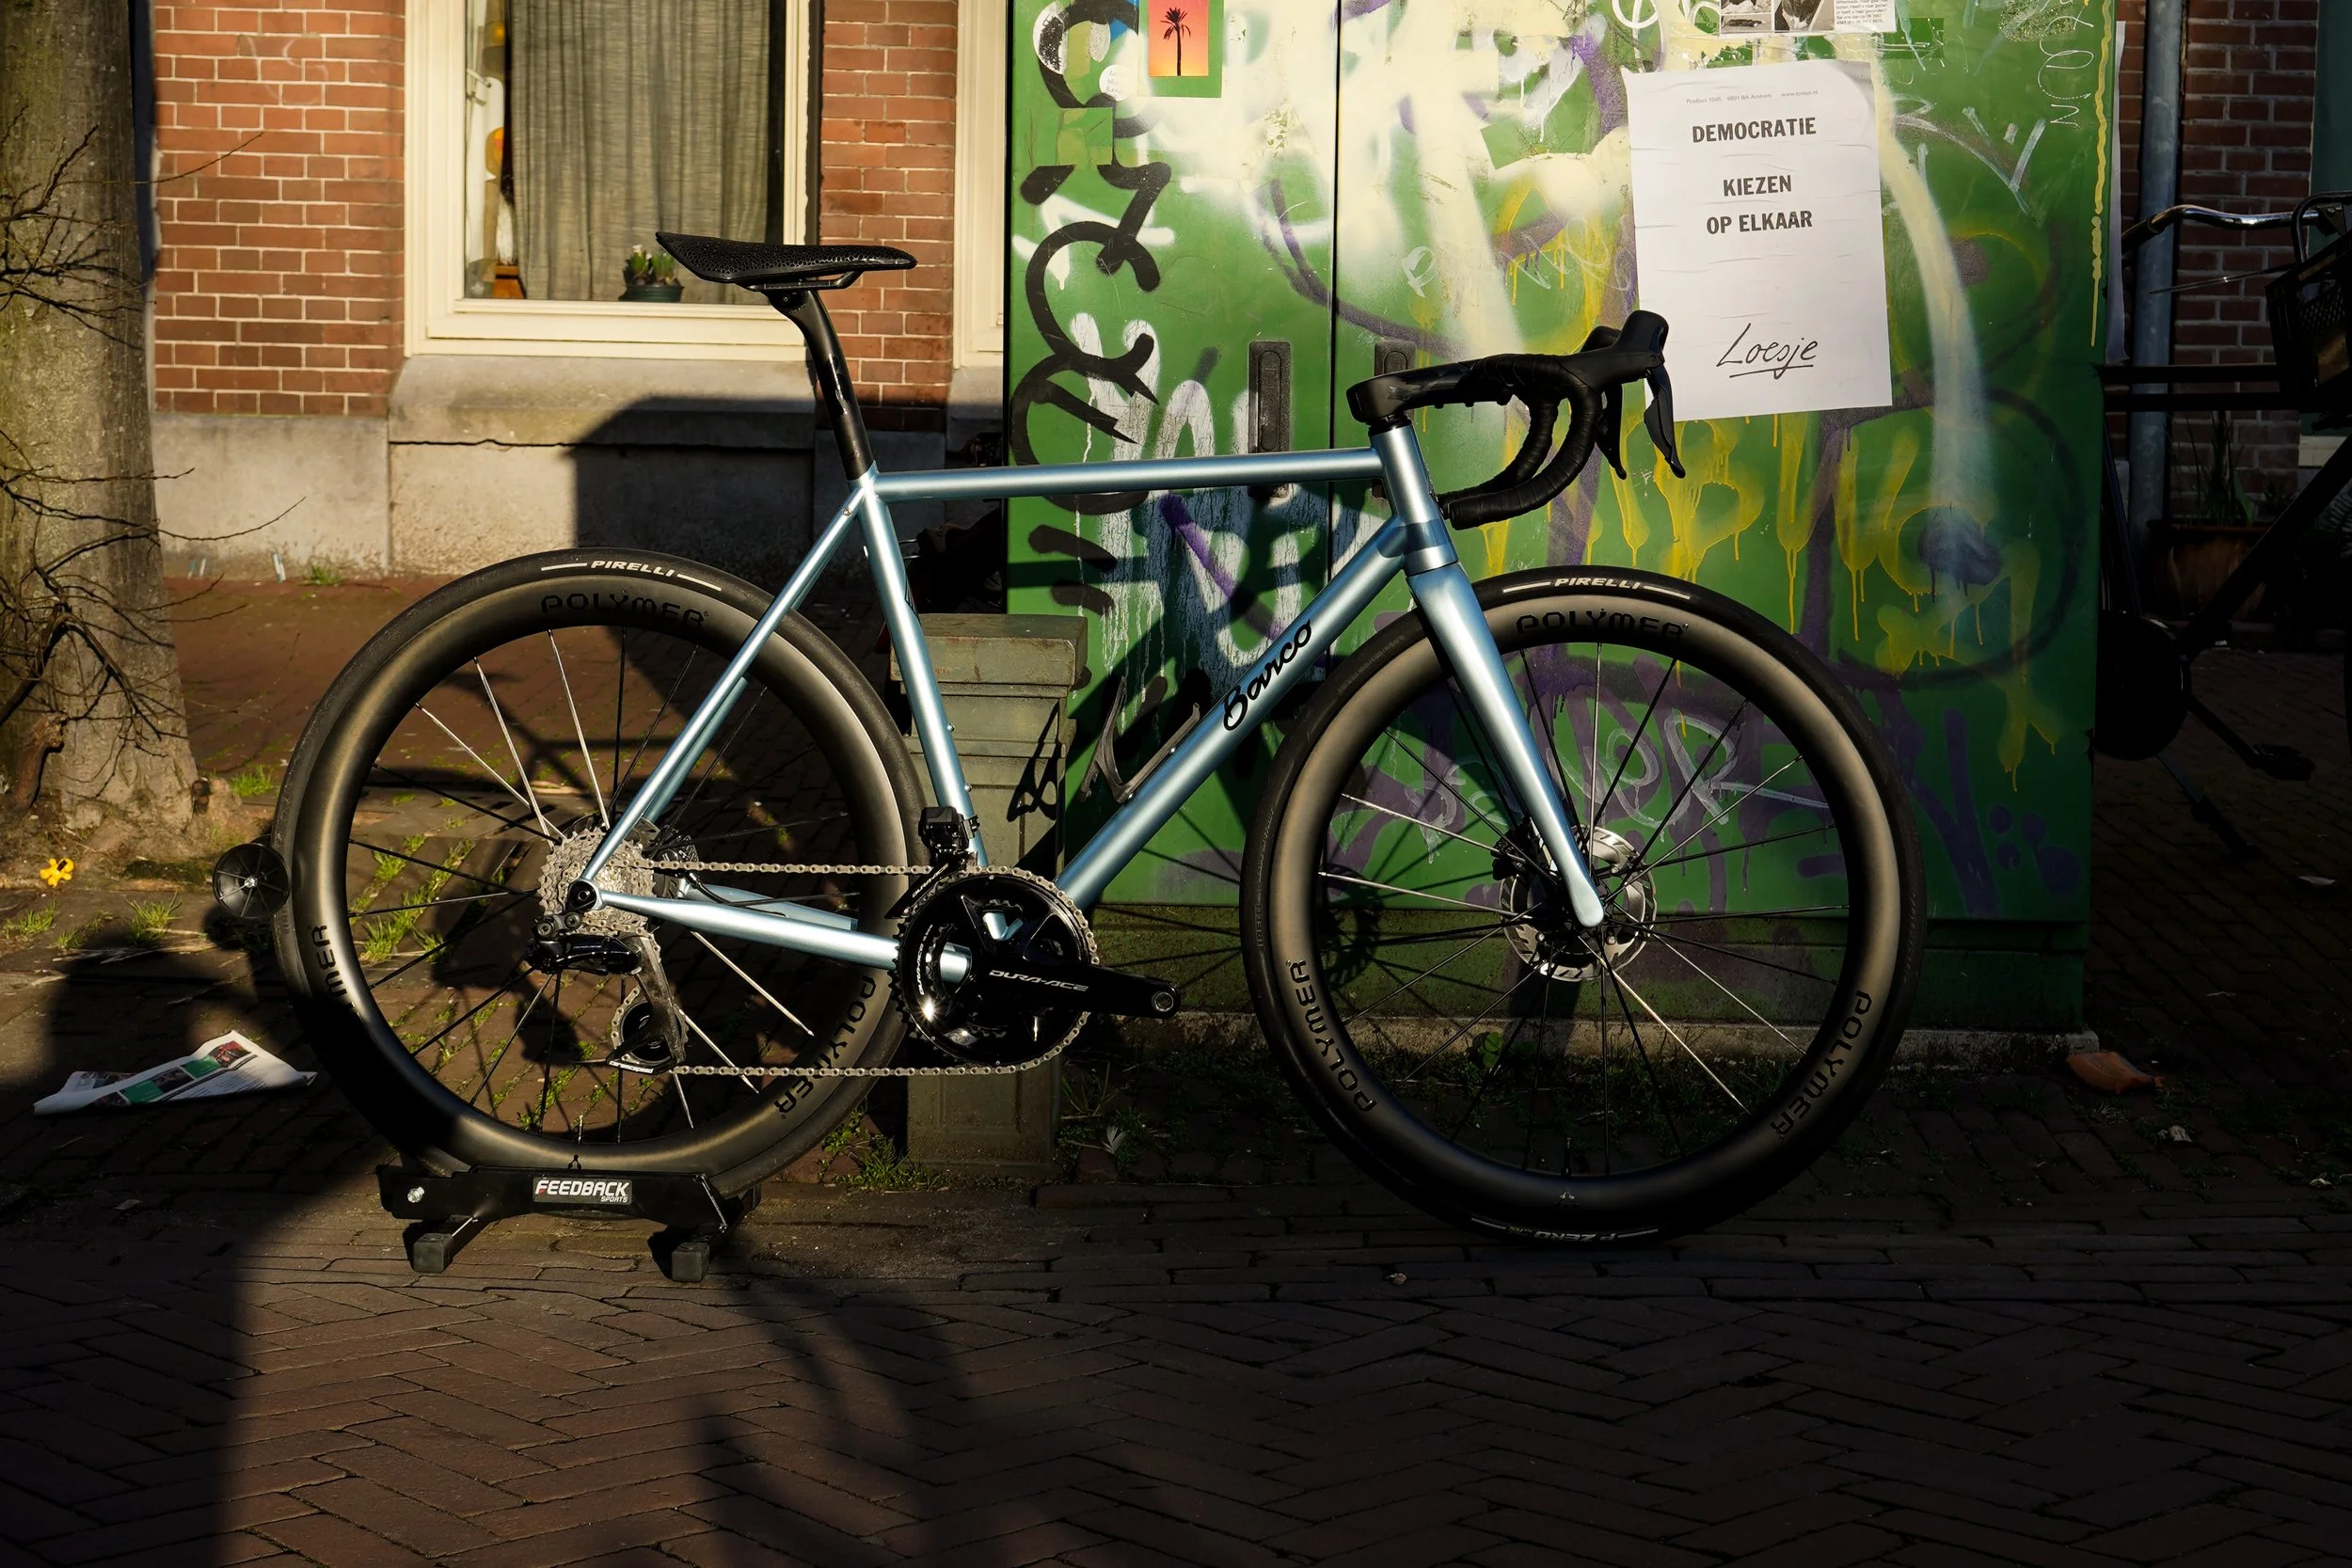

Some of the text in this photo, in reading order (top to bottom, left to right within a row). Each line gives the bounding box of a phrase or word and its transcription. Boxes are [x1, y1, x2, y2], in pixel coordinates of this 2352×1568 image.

[1692, 117, 1817, 143] DEMOCRATIE
[1723, 174, 1791, 197] KIEZEN
[1707, 210, 1813, 234] OP ELKAAR
[1716, 322, 1819, 380] Loesje
[590, 560, 675, 577] PIRELLI
[1554, 577, 1641, 590] PIRELLI
[540, 592, 706, 628] POLYMER
[1516, 610, 1684, 640] POLYMER
[989, 970, 1089, 992] DURA-ACE
[1289, 959, 1378, 1113] POLYMER
[1769, 990, 1872, 1136] POLYMER
[534, 1180, 630, 1197] FEEDBACK
